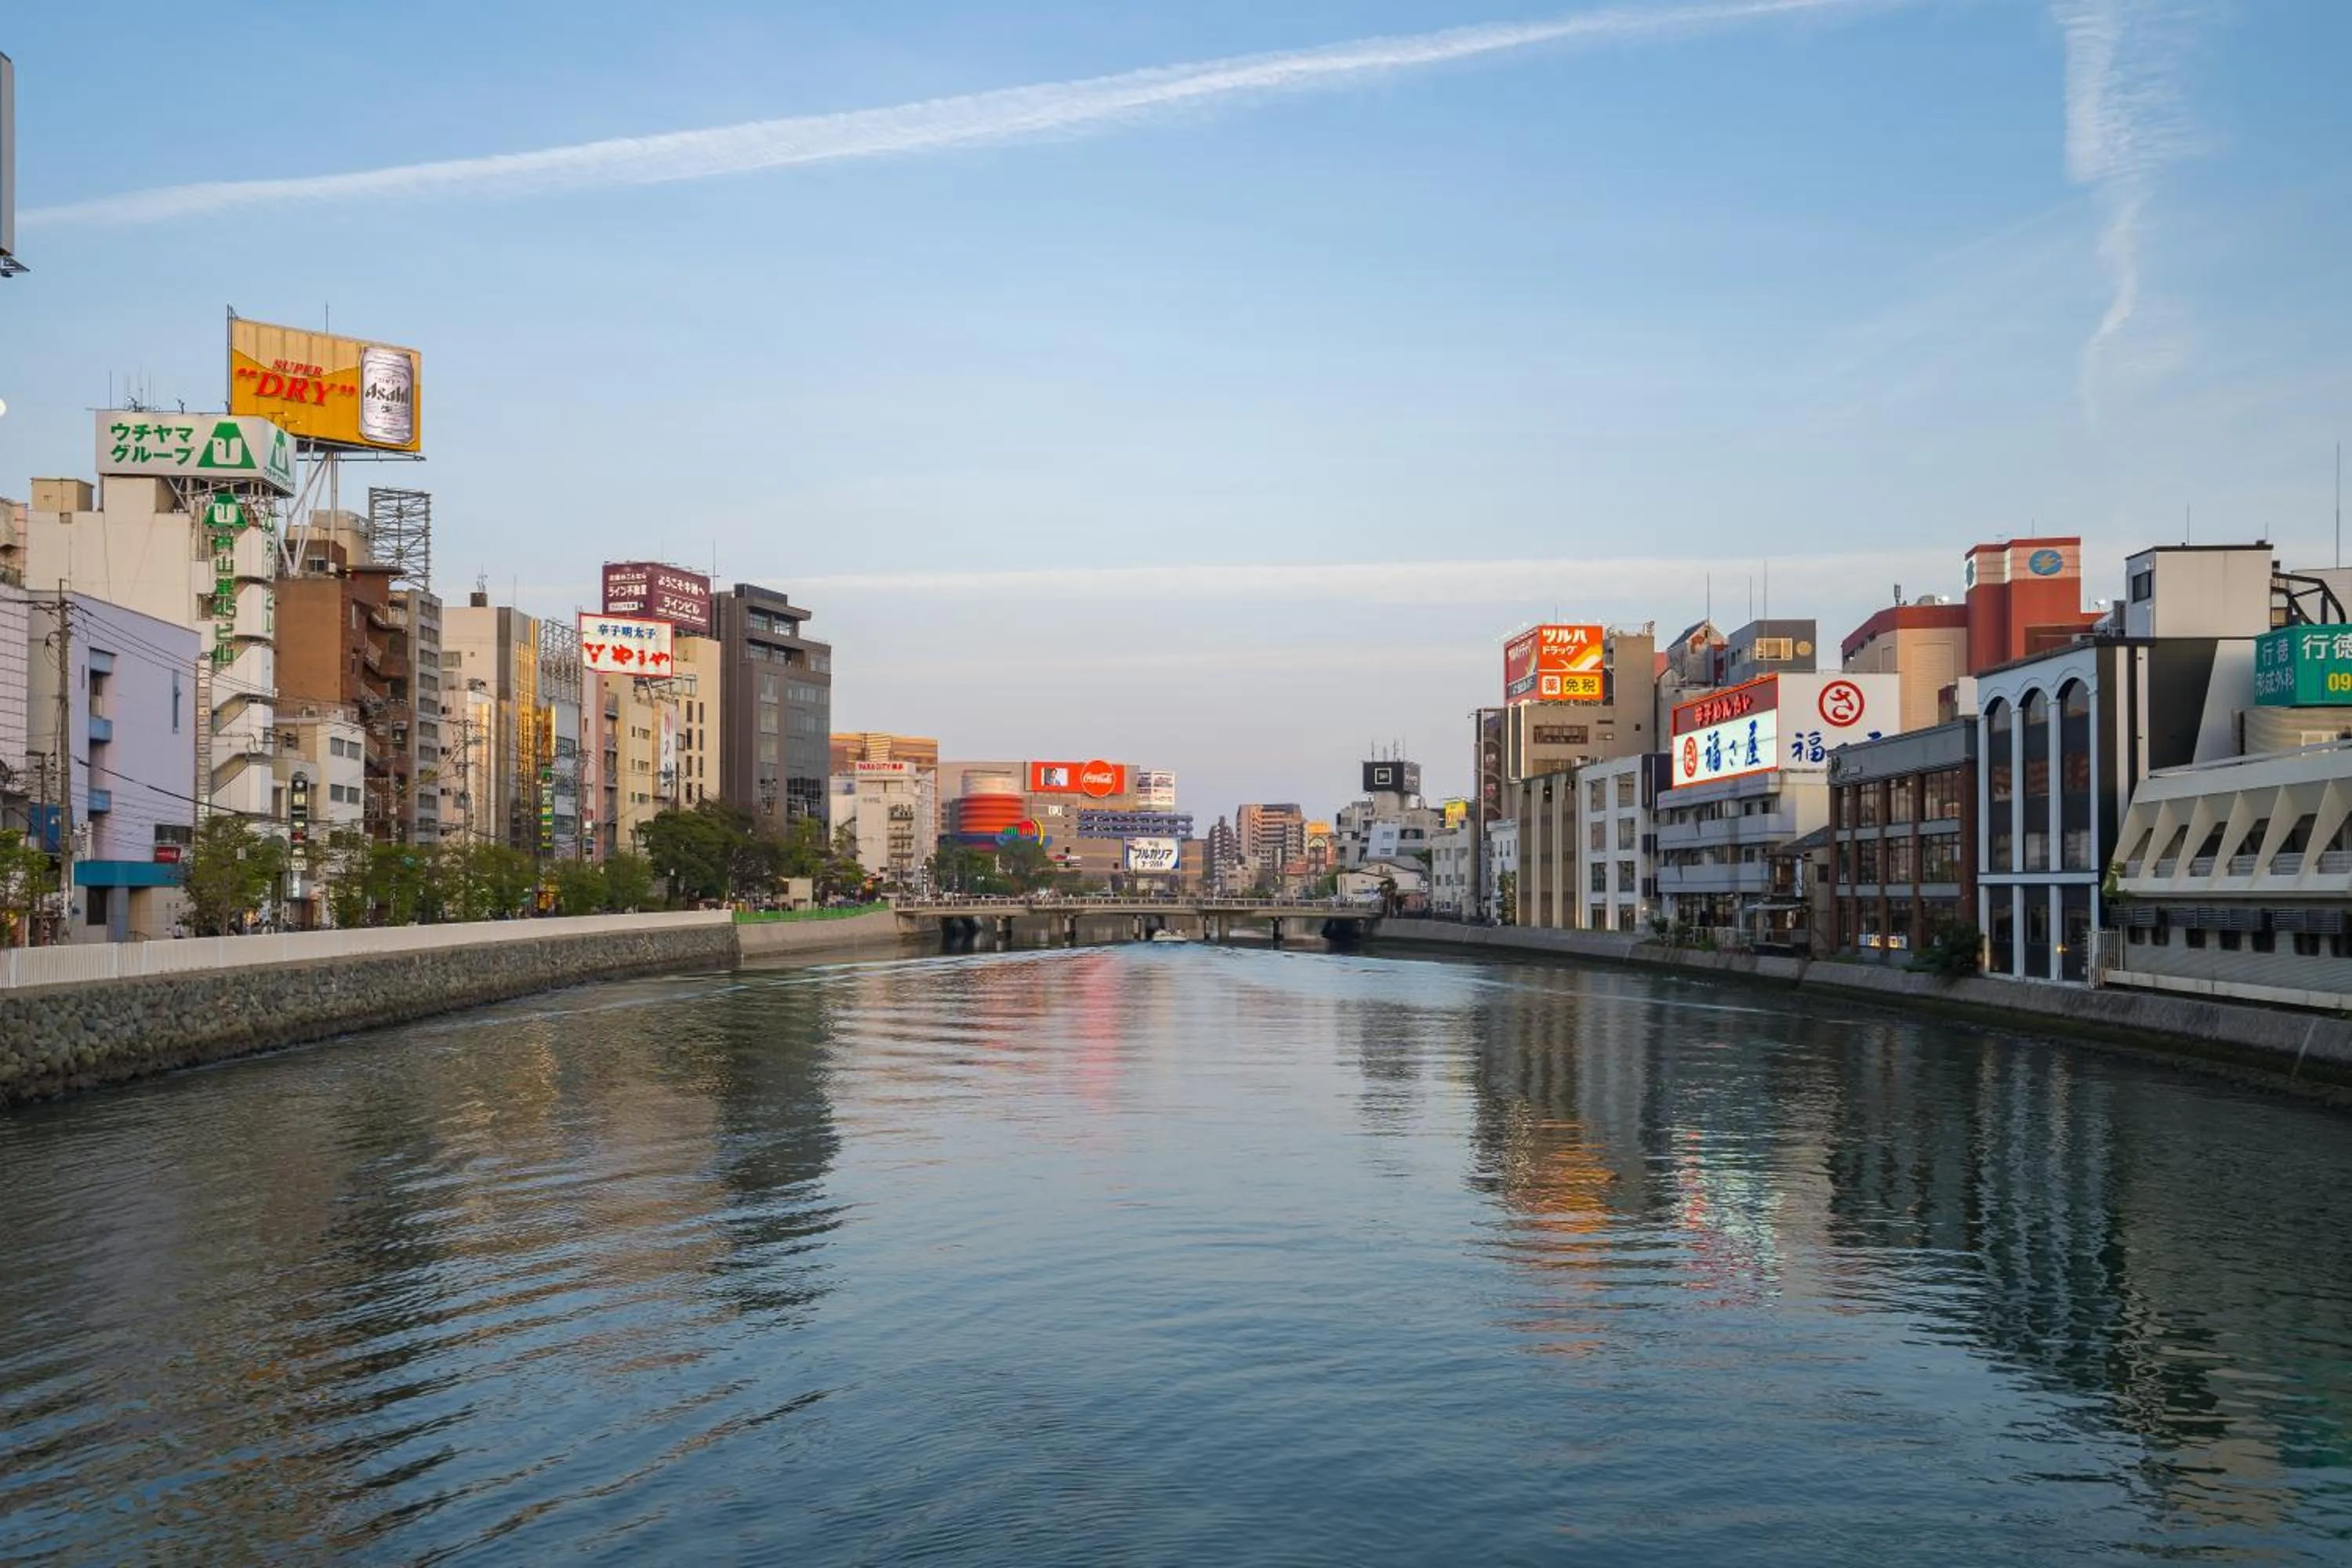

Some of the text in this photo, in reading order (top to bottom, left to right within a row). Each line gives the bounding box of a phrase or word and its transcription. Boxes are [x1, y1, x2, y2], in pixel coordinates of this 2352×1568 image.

[274, 358, 323, 378] SUPER
[111, 423, 194, 443] ウチヤマ
[111, 445, 195, 466] グループ
[598, 623, 656, 639] 辛子明太子
[1542, 628, 1588, 644] ツルハ
[1542, 645, 1578, 655] ドラッグ
[1566, 678, 1595, 691] 免税
[1705, 720, 1762, 772] 福さ屋
